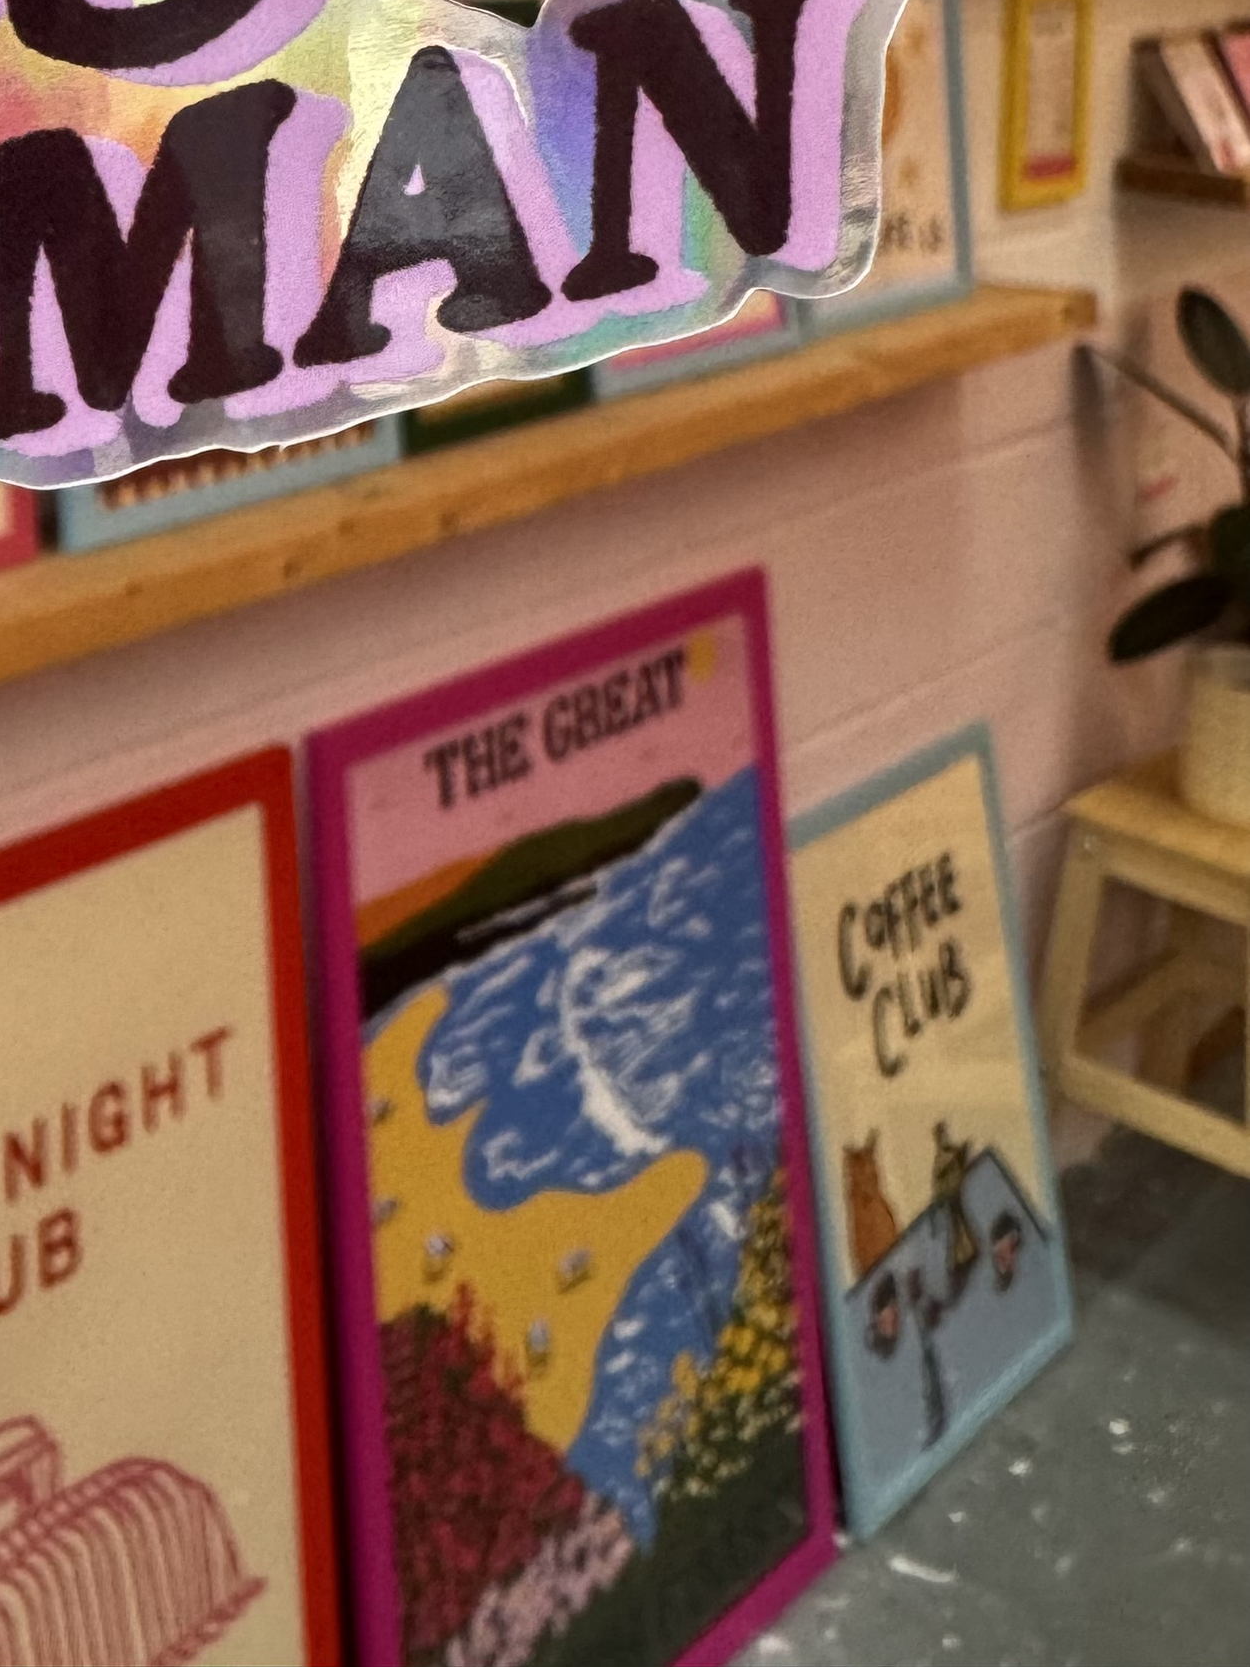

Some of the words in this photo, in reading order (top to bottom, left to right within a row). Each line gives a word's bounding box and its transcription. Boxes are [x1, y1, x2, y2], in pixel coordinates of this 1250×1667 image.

[423, 711, 534, 811] THE
[540, 647, 687, 764] GREAT
[838, 851, 962, 1002] COFFEE
[872, 937, 972, 1078] CLUB
[1, 1026, 236, 1203] NIGHT
